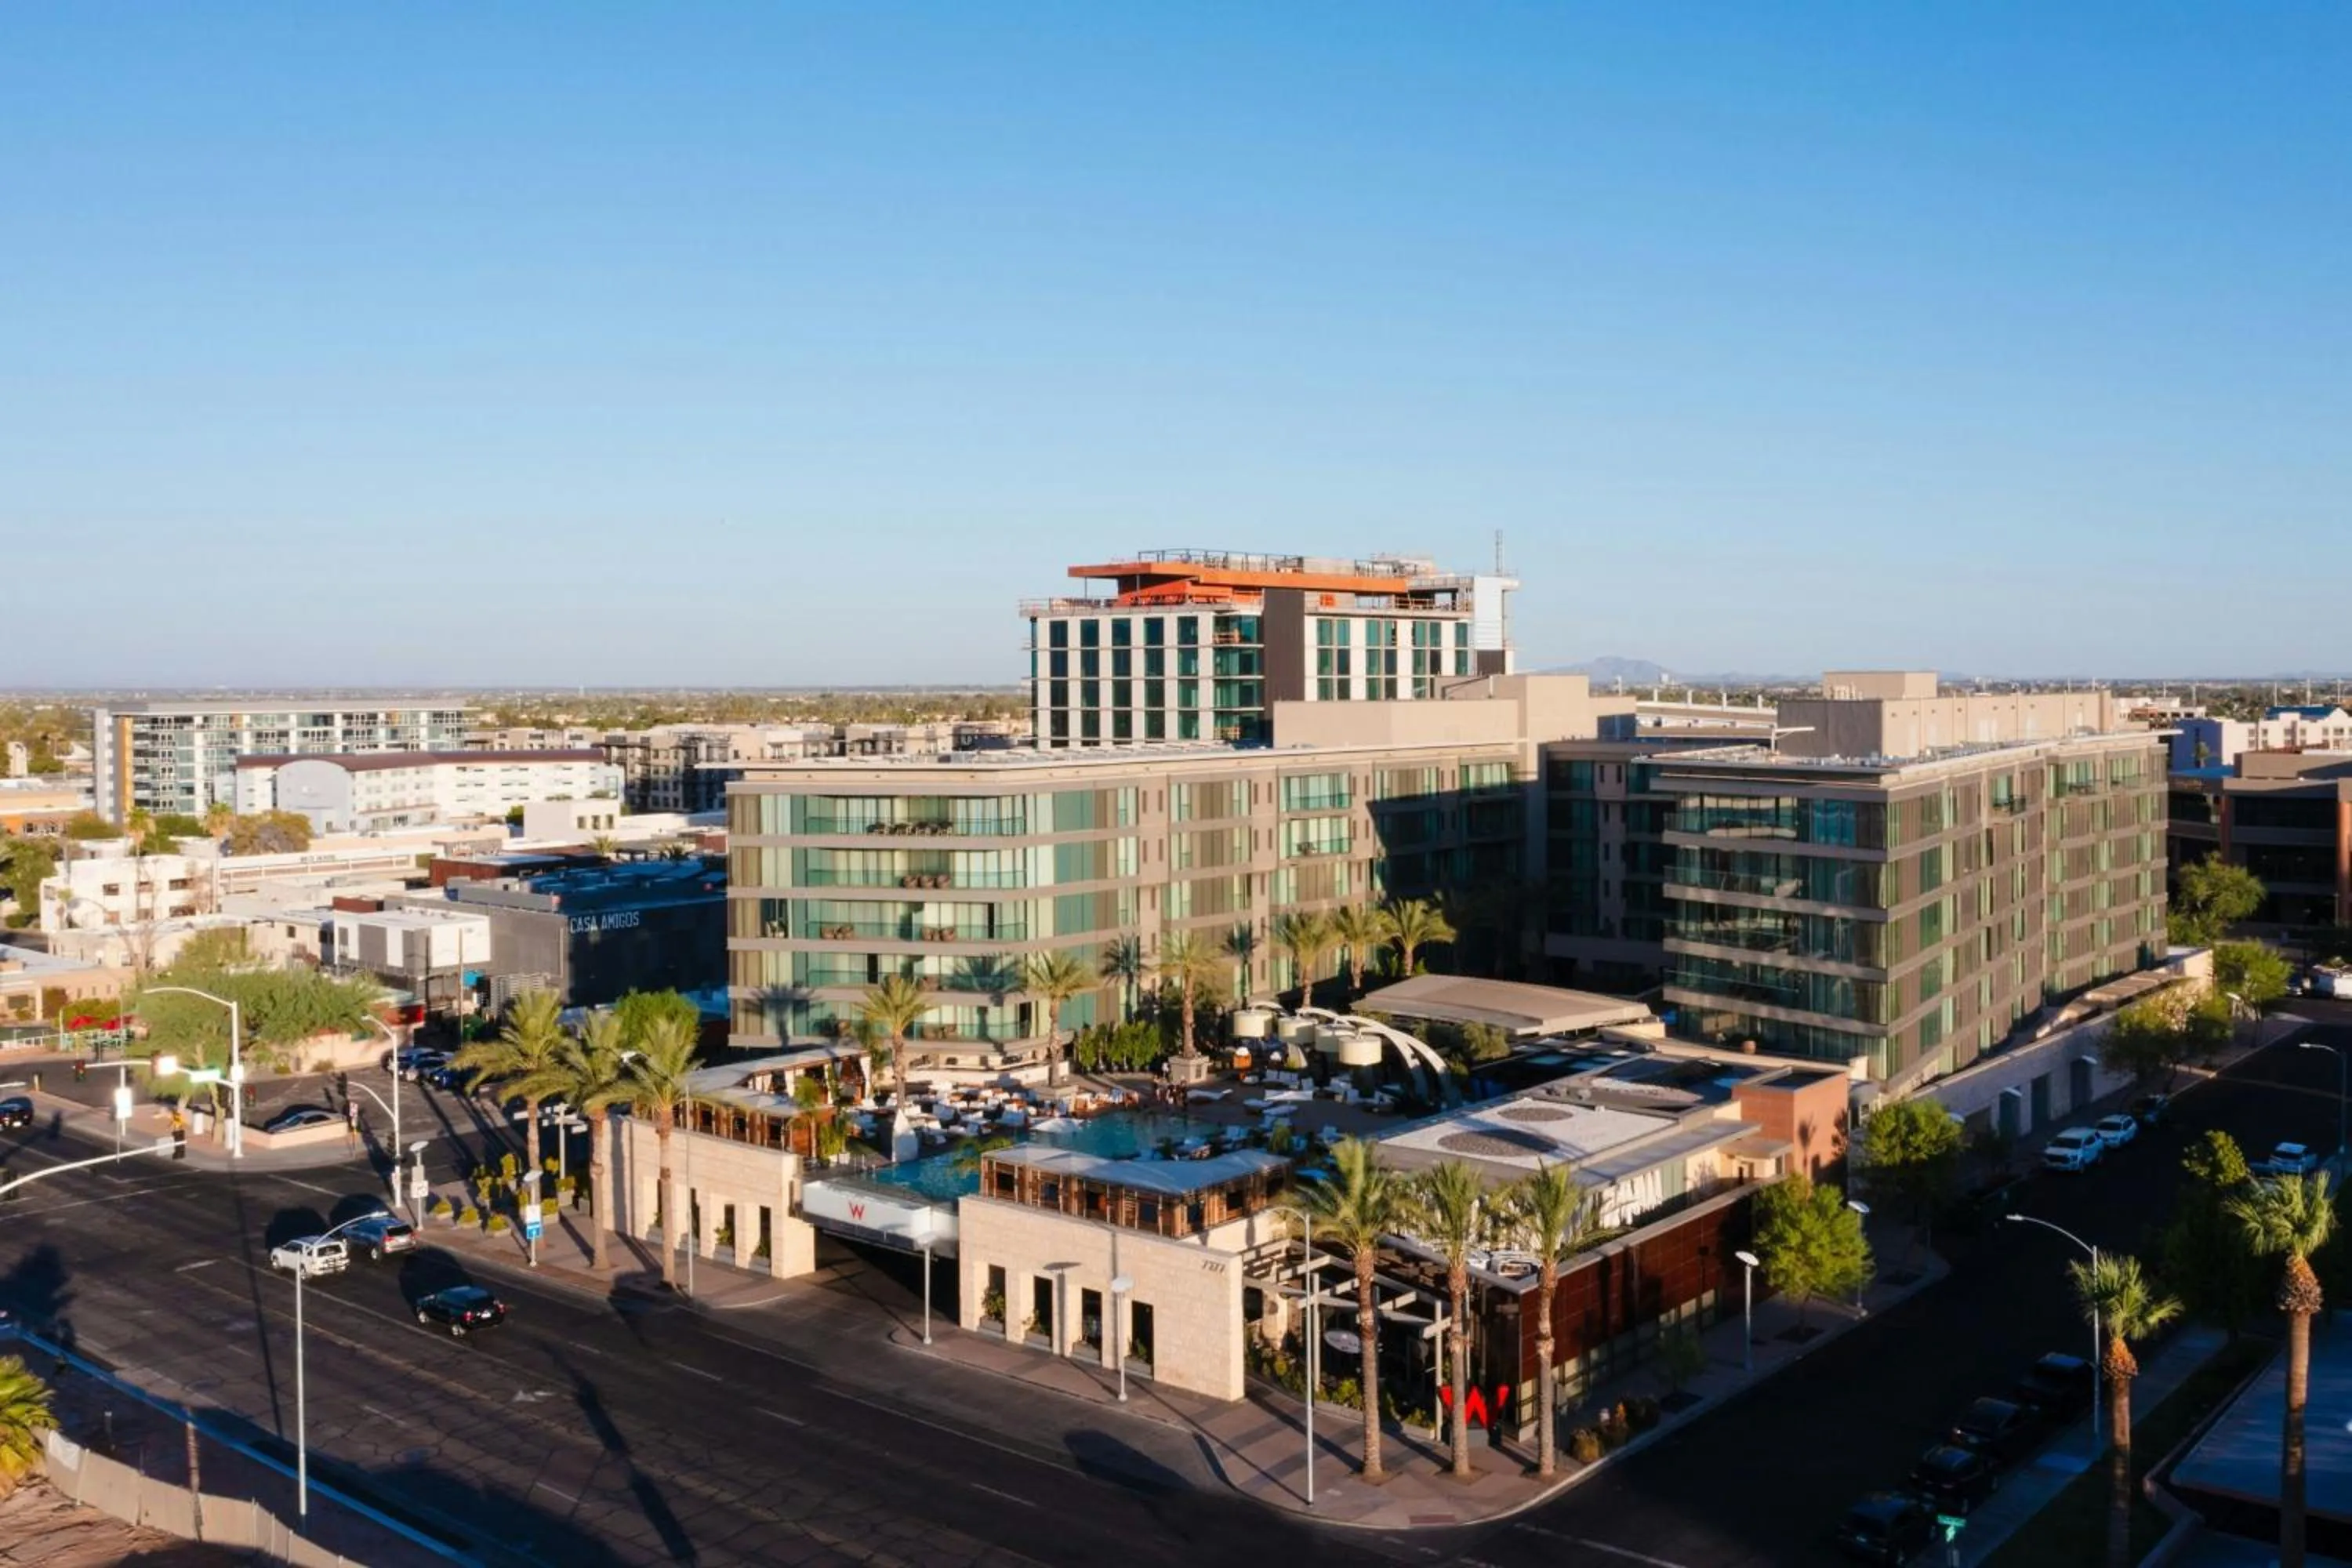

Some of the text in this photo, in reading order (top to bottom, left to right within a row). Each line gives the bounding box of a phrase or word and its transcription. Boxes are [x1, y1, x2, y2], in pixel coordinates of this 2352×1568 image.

[570, 912, 640, 934] CASA AMIGOS
[848, 1202, 866, 1220] W
